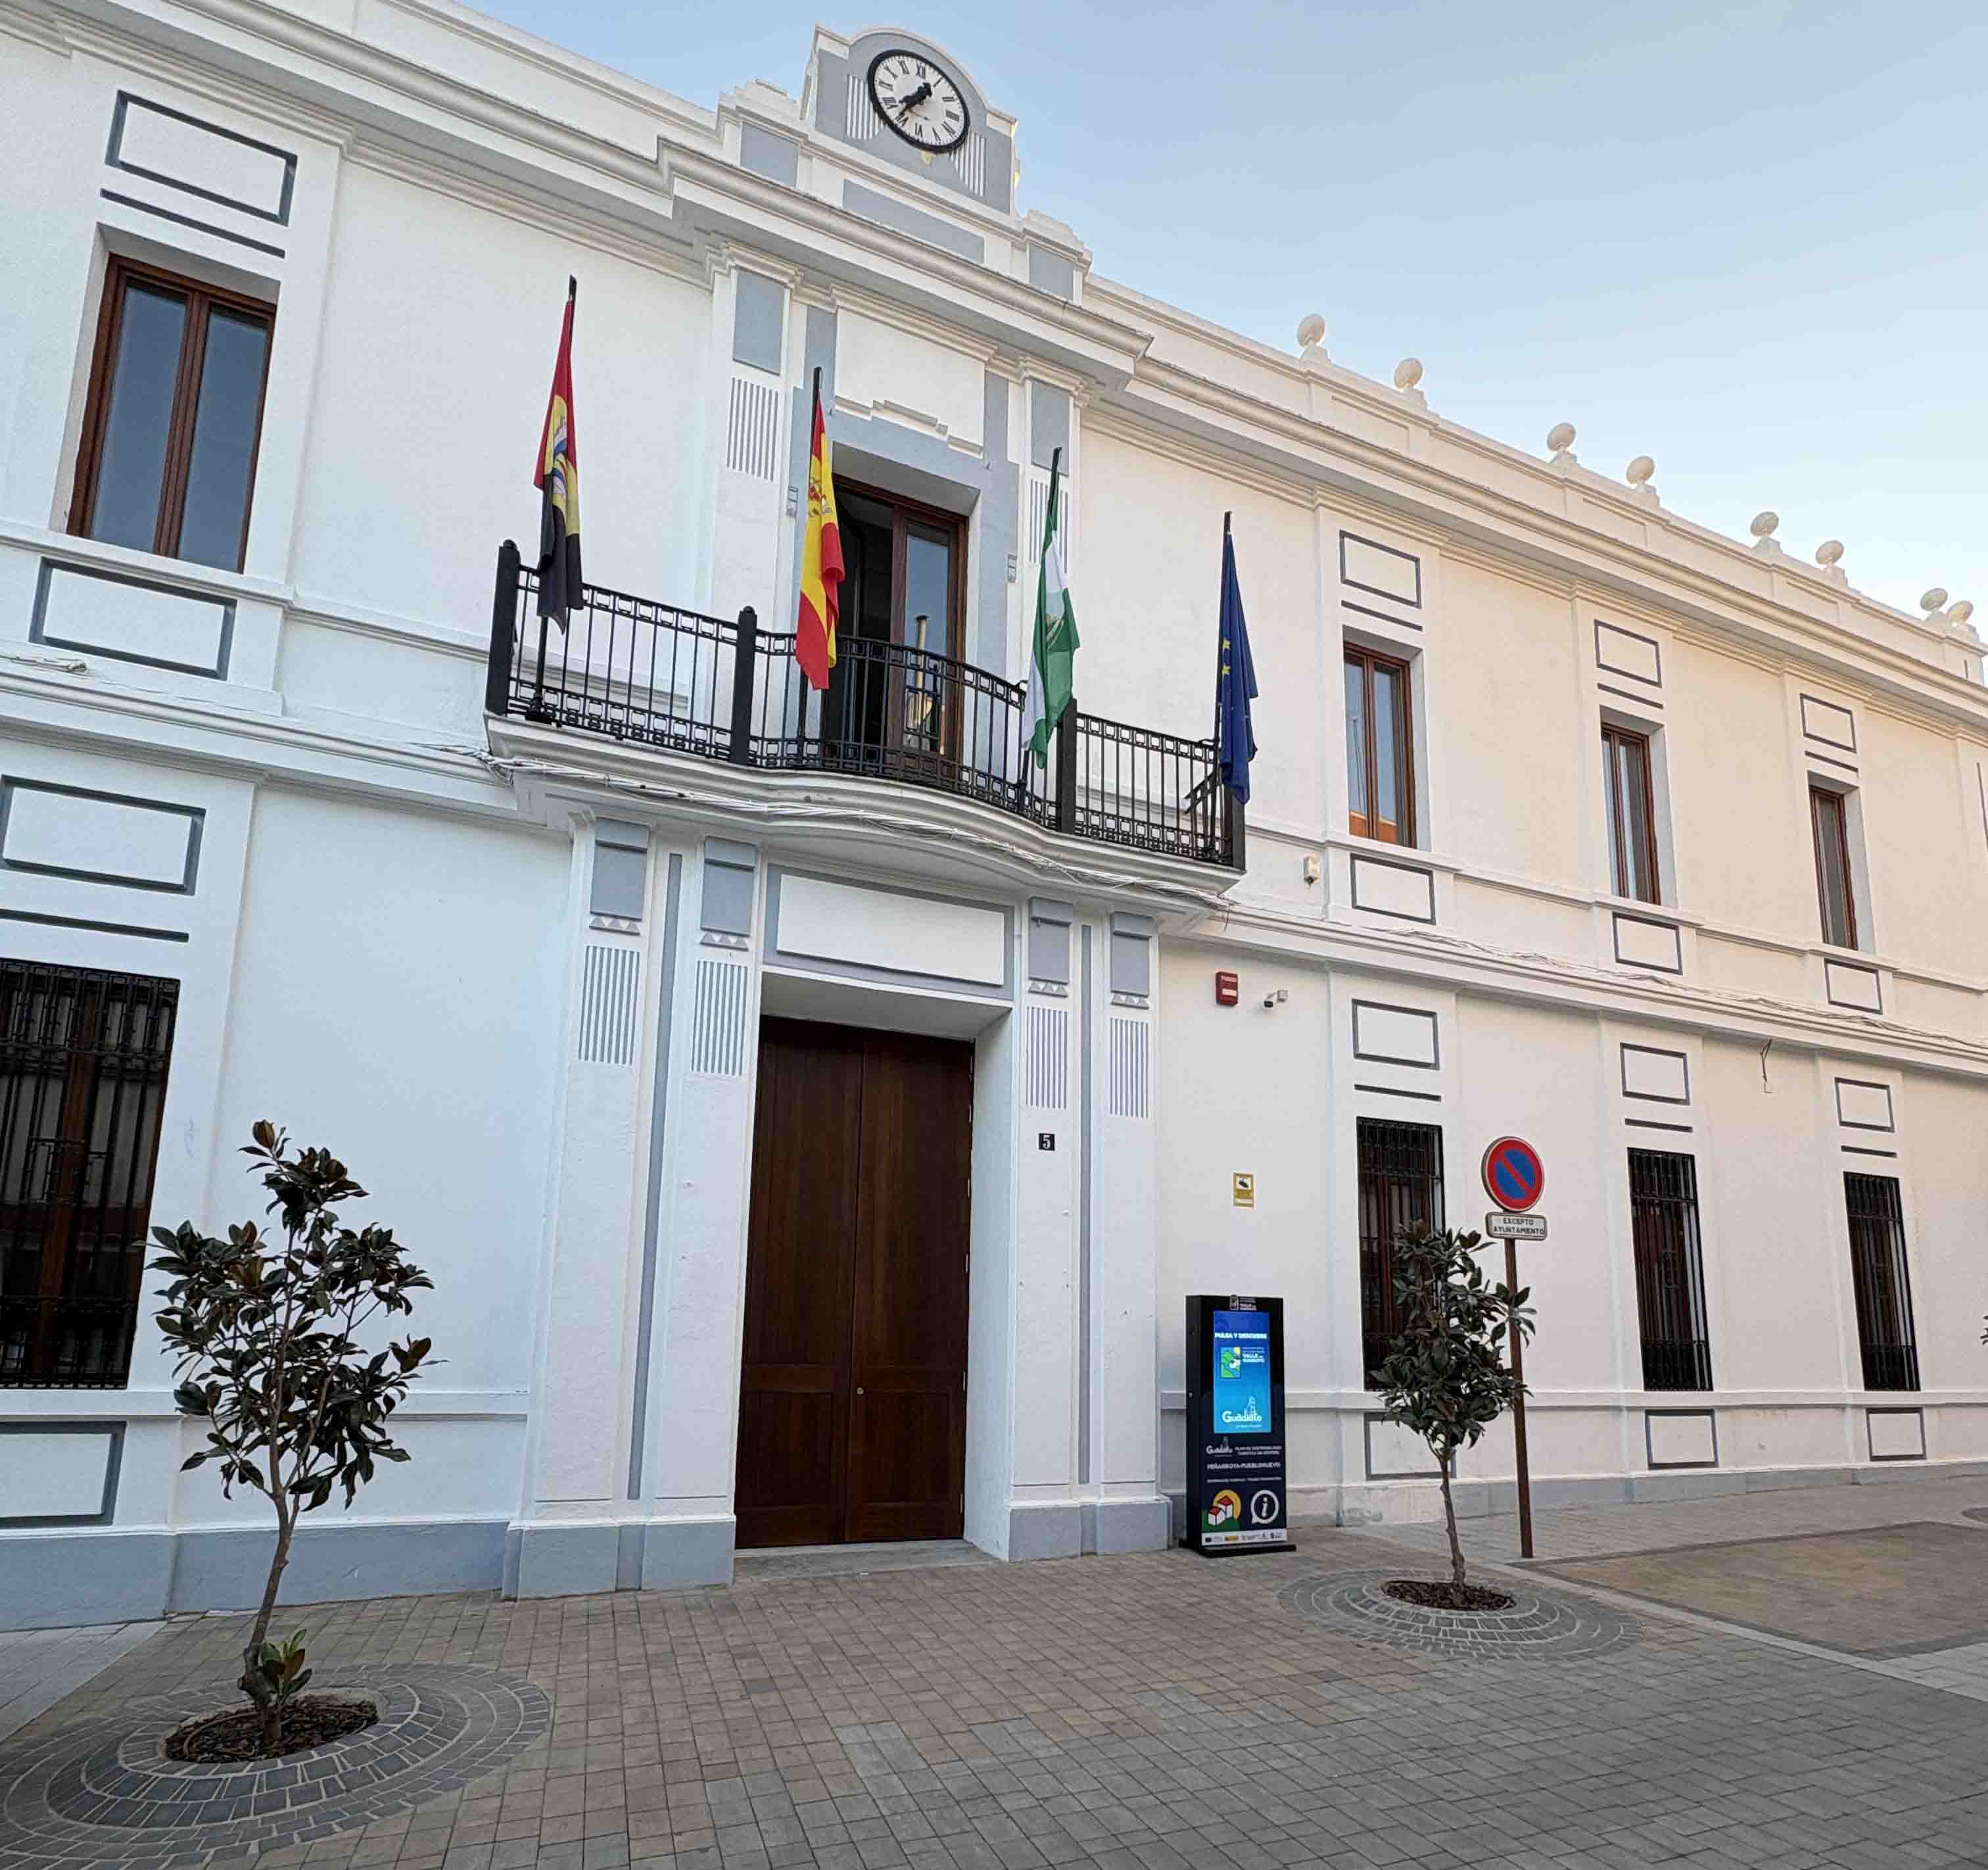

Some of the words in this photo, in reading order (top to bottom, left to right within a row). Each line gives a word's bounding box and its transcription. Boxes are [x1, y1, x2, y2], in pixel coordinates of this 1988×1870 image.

[916, 62, 926, 80] XII
[1043, 1134, 1051, 1149] 5
[1503, 1217, 1534, 1226] EXCEPTO
[1493, 1225, 1545, 1235] AYUNTAMIENTO
